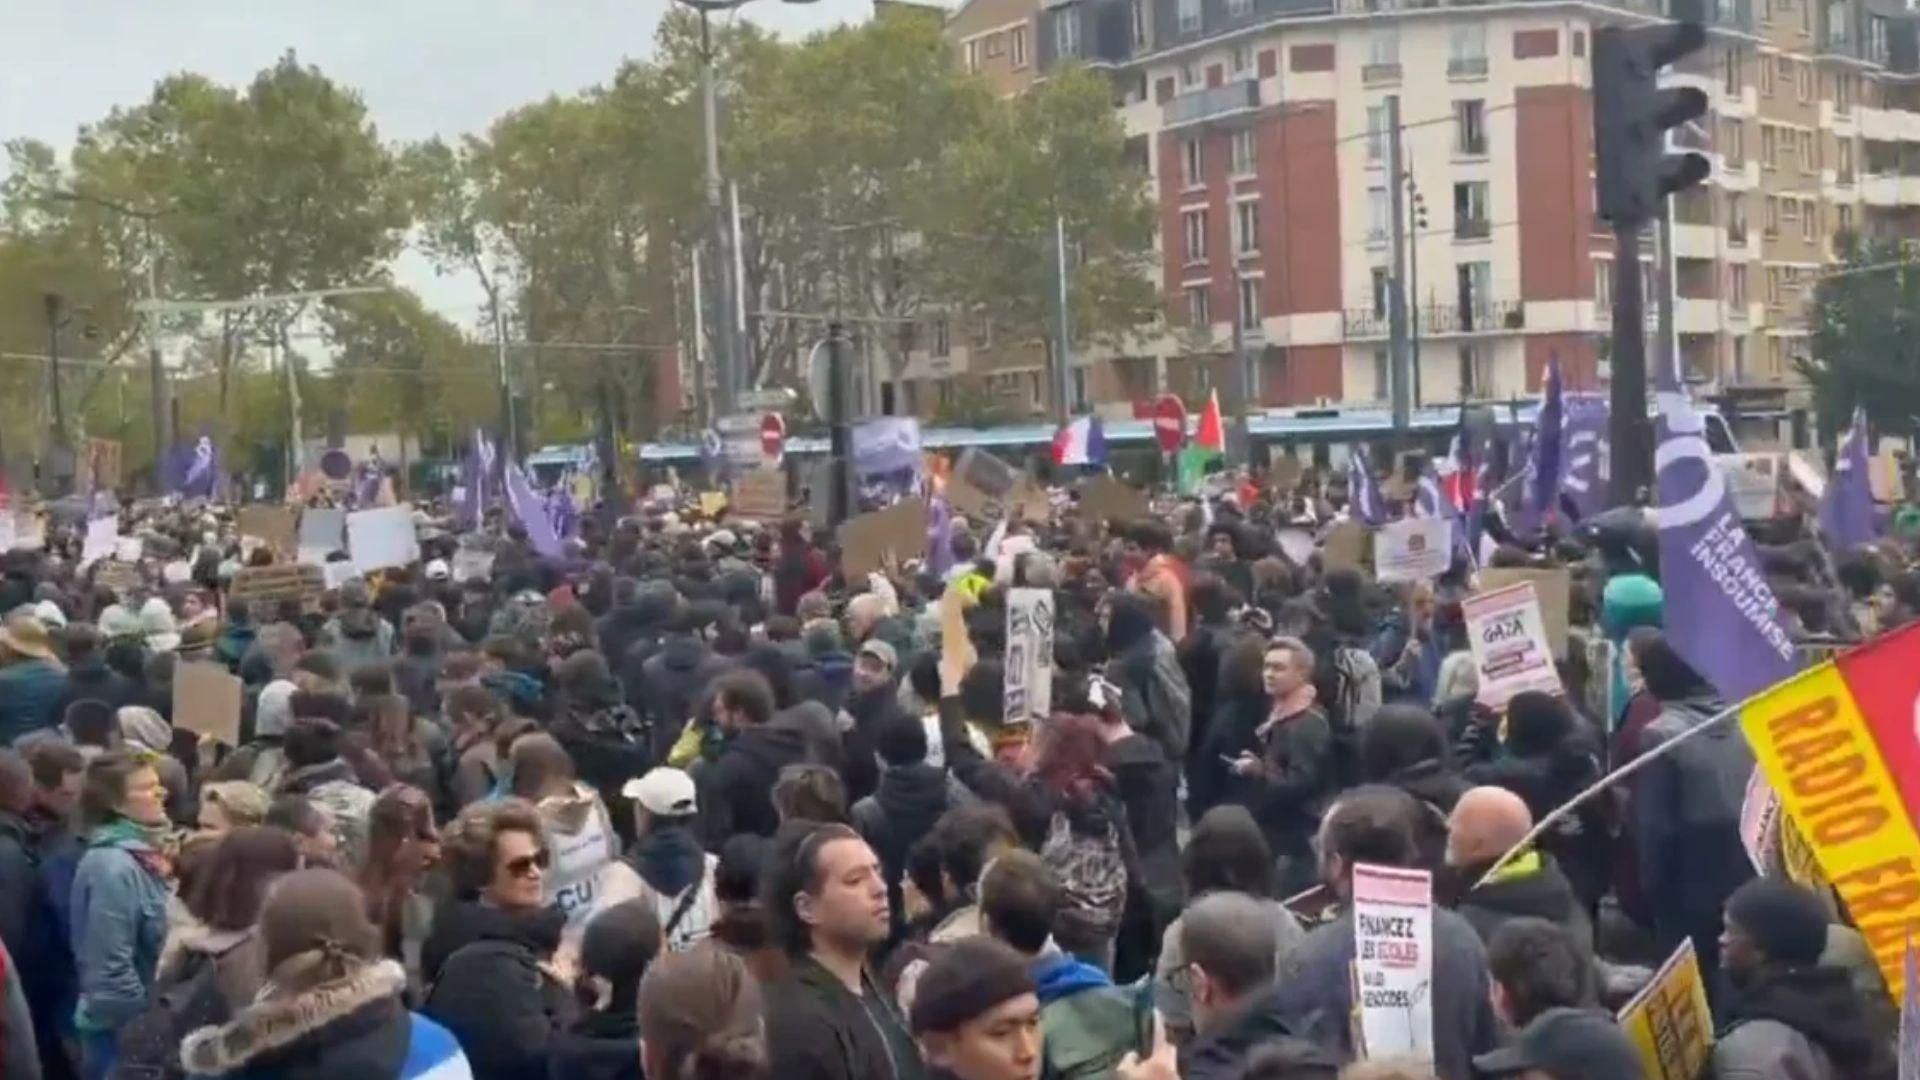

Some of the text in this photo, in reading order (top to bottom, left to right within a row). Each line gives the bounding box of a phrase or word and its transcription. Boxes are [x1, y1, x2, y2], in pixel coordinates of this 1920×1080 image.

[1717, 513, 1746, 548] LA
[1690, 541, 1795, 662] INSOUMISE
[1482, 618, 1526, 643] GAZA
[1767, 696, 1891, 848] RADIO
[555, 873, 599, 912] CU
[1358, 913, 1415, 939] FINANCEZ
